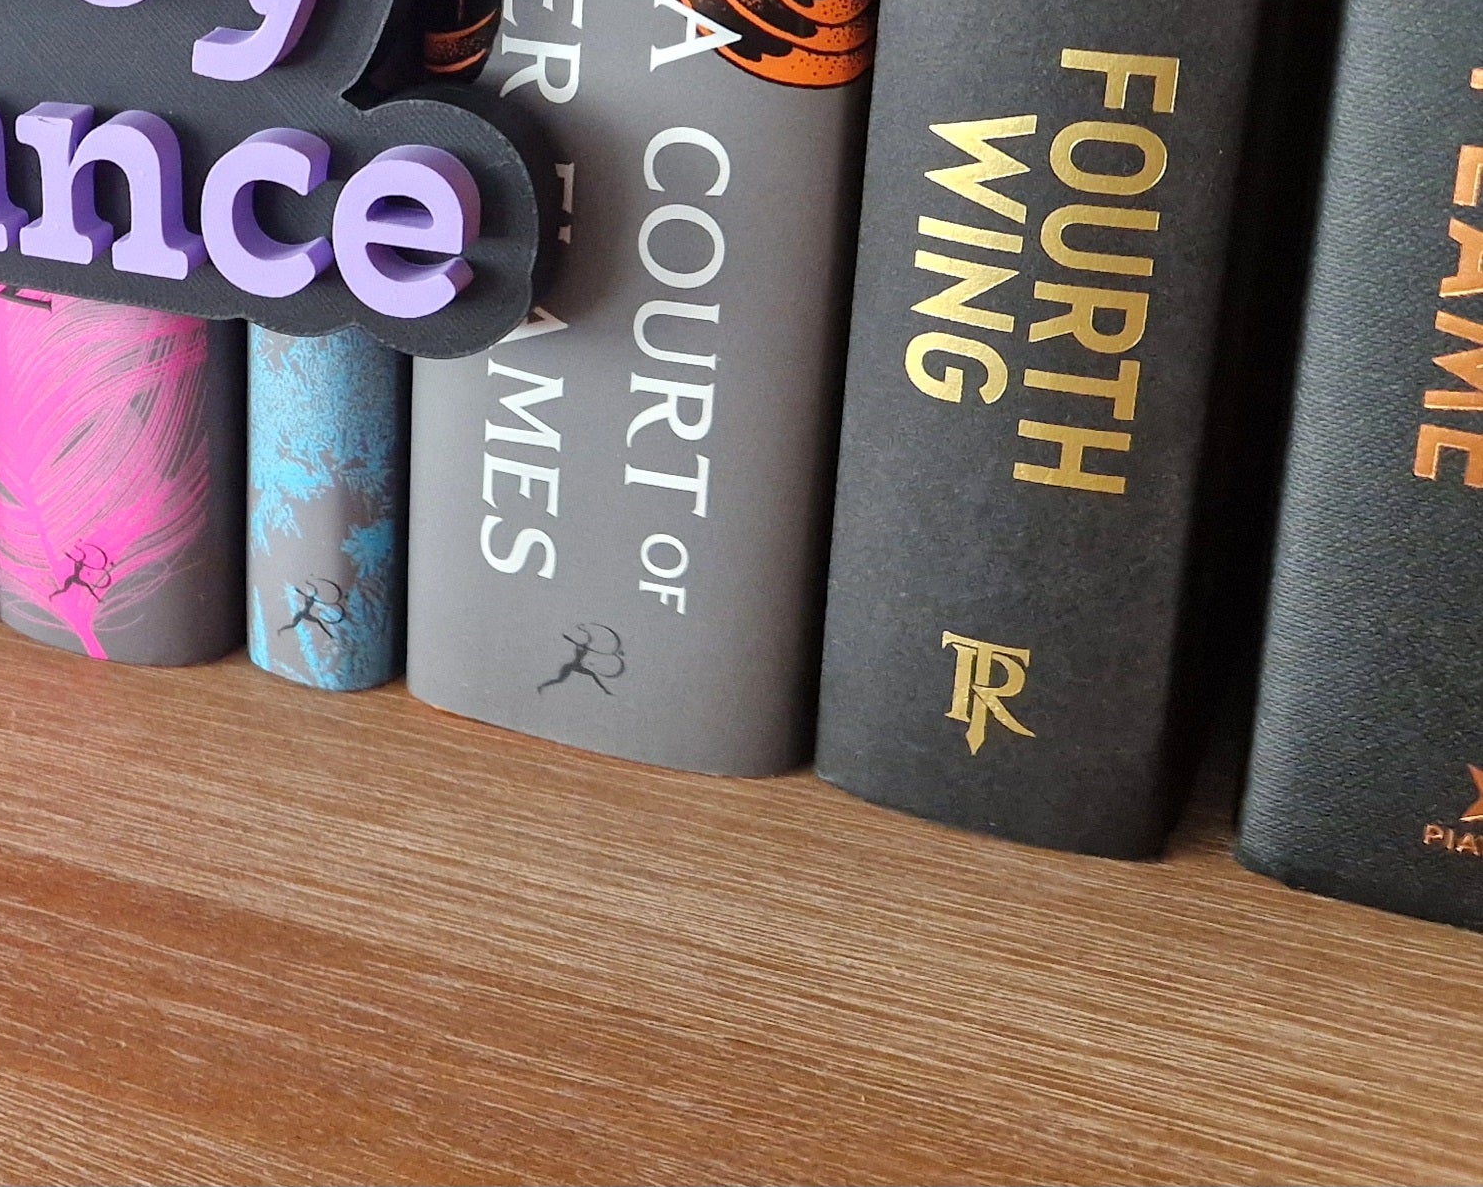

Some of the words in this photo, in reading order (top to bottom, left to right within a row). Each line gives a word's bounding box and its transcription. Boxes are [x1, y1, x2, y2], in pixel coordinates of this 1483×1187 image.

[624, 127, 730, 517] COURT
[903, 114, 1038, 406] WING
[1012, 48, 1181, 496] FOURTH
[639, 533, 689, 614] OF
